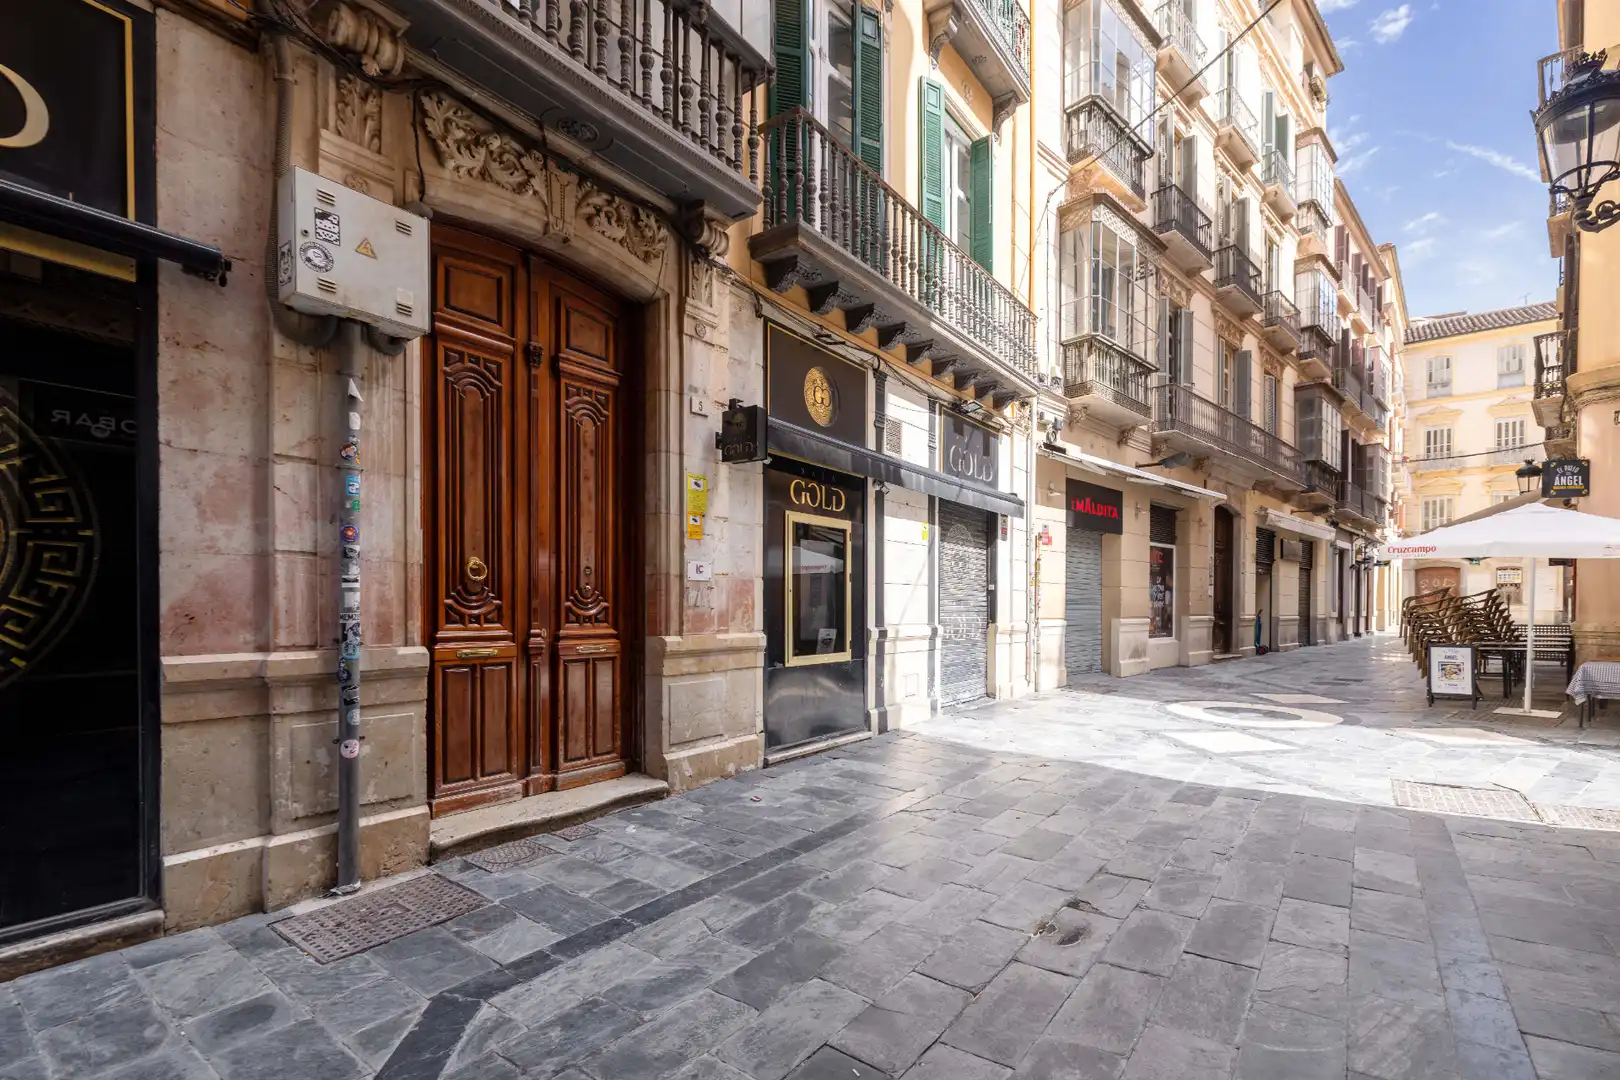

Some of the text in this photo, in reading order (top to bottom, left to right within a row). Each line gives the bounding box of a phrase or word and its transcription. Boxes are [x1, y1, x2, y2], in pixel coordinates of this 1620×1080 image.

[950, 444, 993, 482] GOLD
[1554, 474, 1584, 486] ÁNGEL
[790, 479, 846, 512] GOLD
[1387, 545, 1437, 554] Cruzcampo
